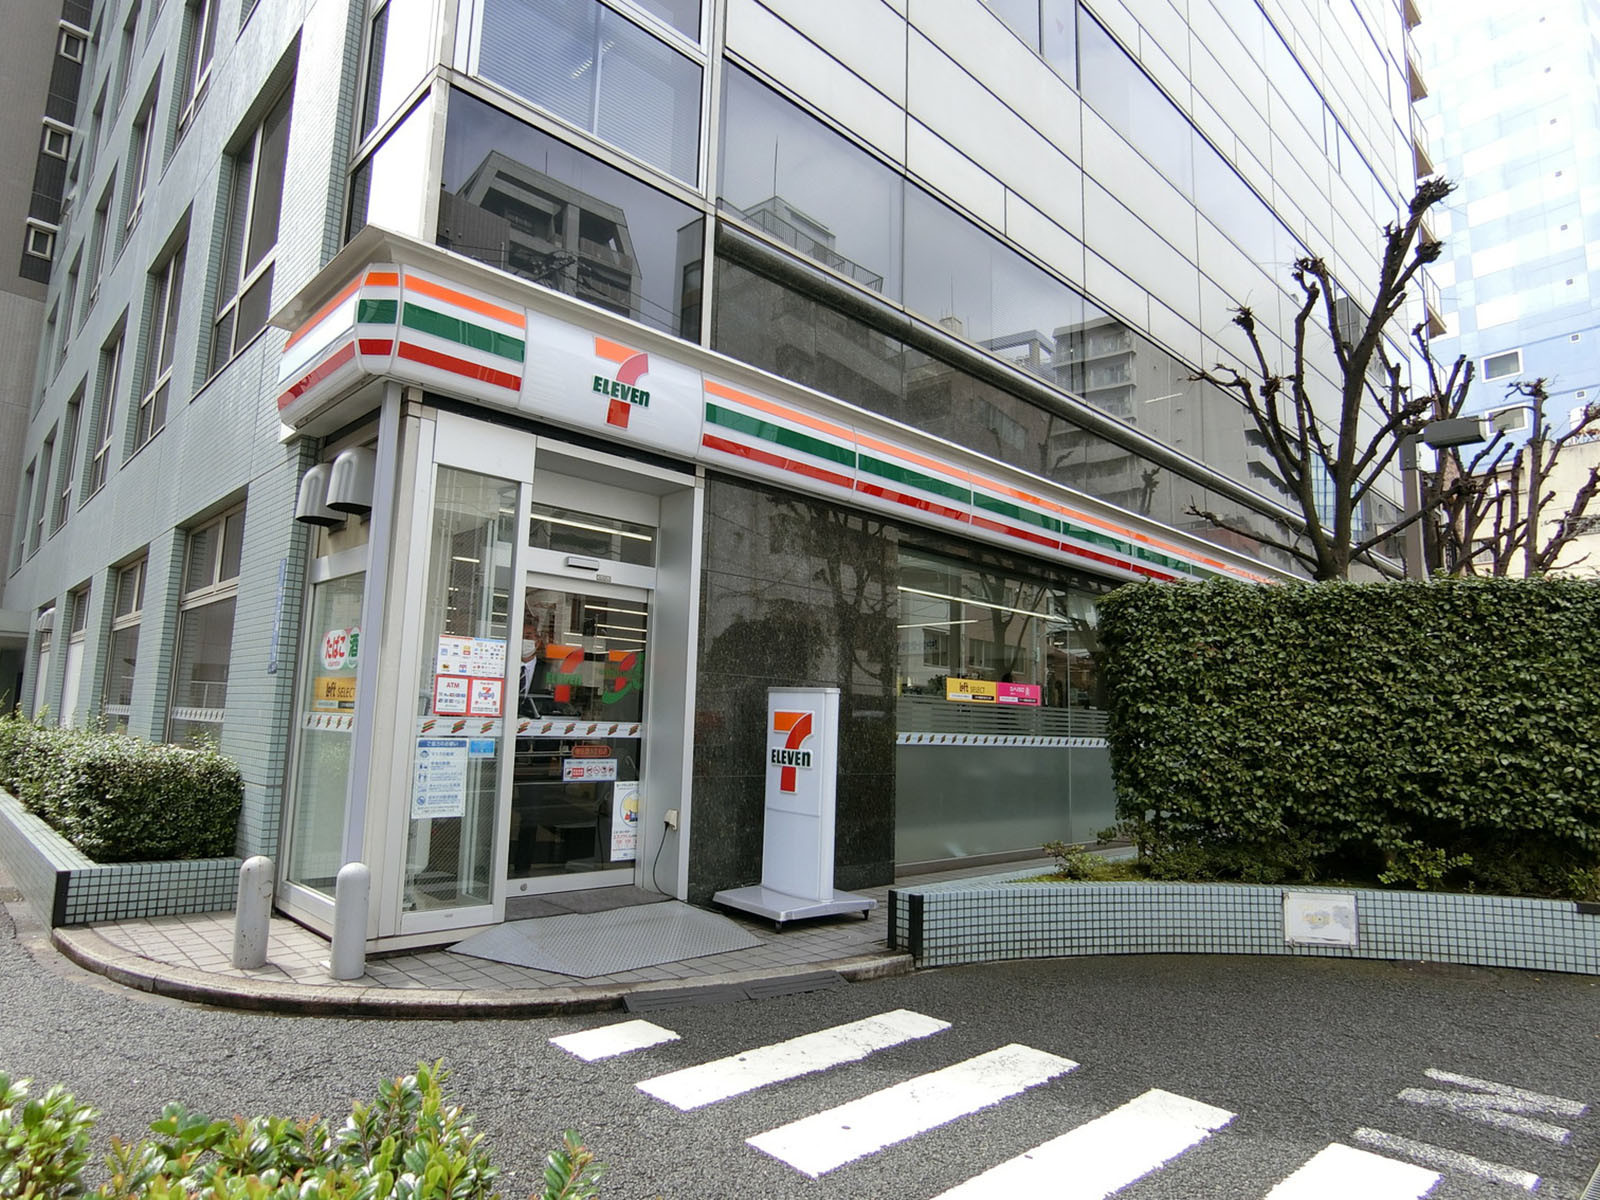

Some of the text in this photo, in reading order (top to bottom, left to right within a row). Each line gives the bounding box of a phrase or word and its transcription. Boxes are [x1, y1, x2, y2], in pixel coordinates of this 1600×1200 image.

[325, 634, 347, 660] たばこ
[446, 681, 460, 689] ATM
